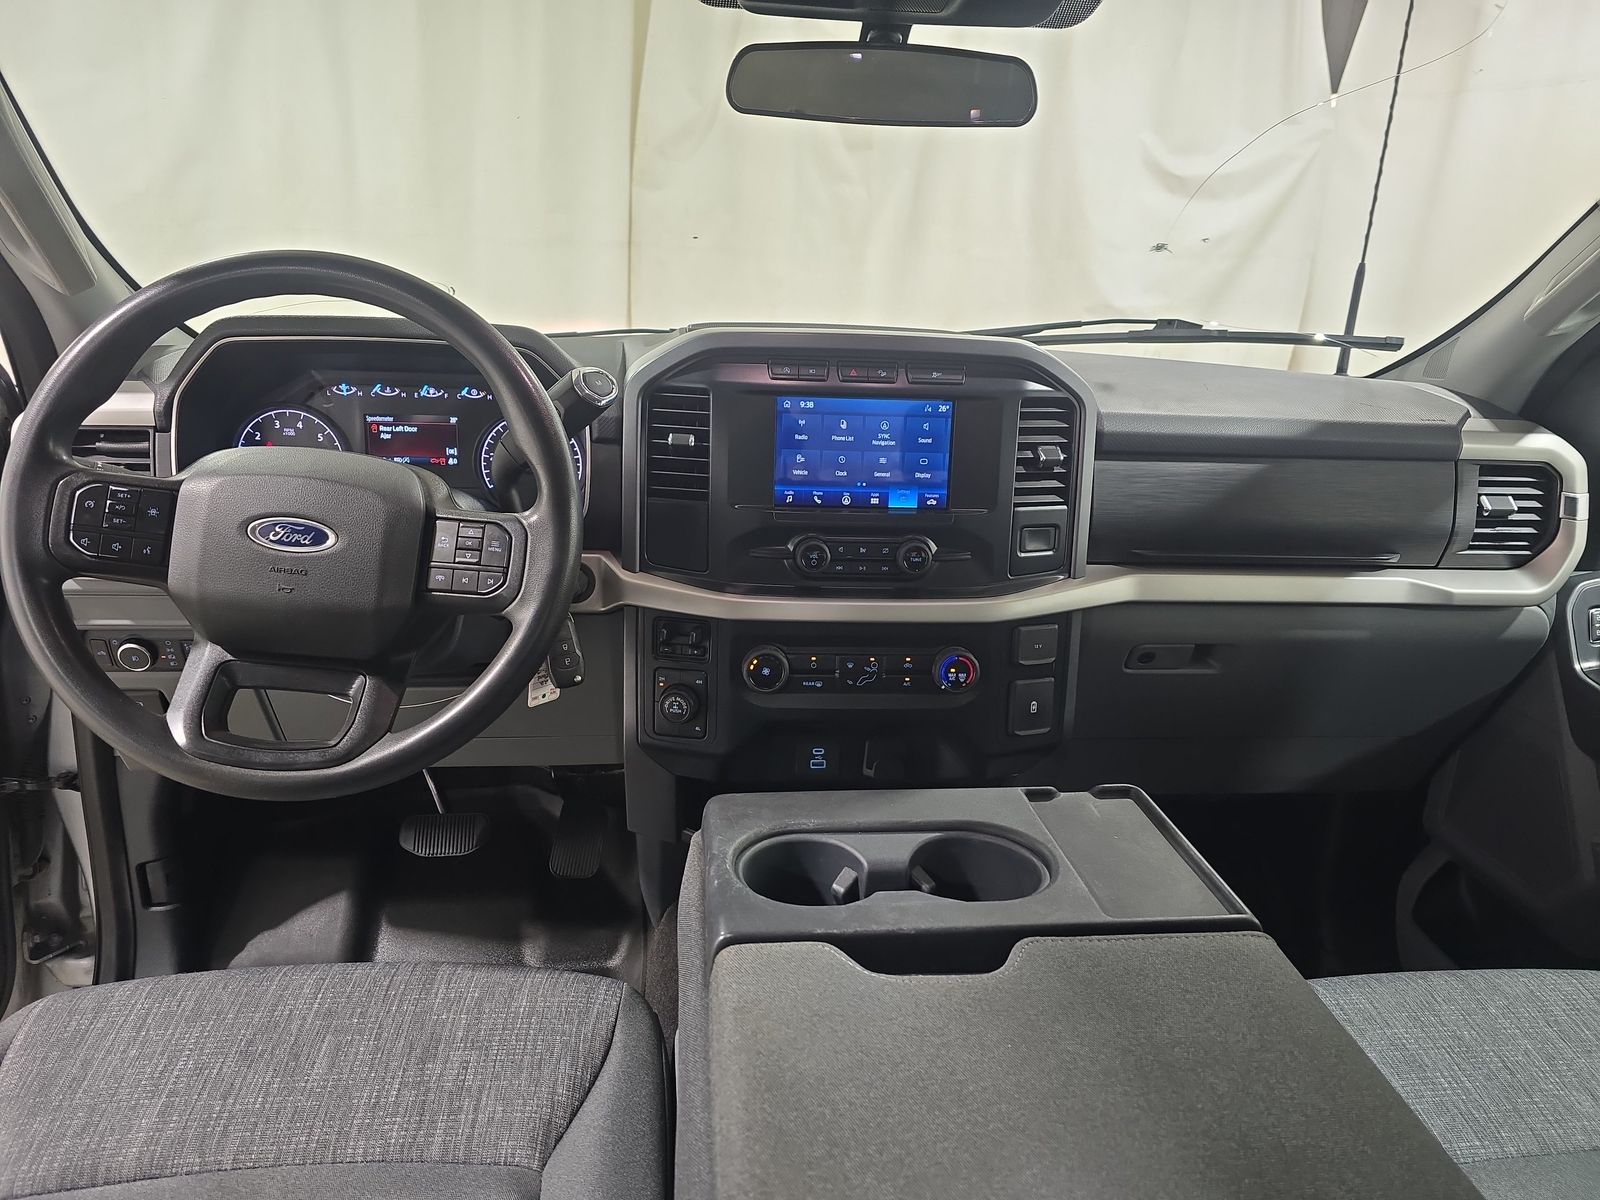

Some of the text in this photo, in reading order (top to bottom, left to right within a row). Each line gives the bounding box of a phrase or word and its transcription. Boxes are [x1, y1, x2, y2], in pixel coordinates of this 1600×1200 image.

[274, 421, 280, 429] 3
[296, 421, 303, 429] 4
[254, 432, 261, 440] 2
[317, 433, 323, 442] 5
[266, 523, 315, 545] Ford
[268, 565, 309, 576] AIRBAG
